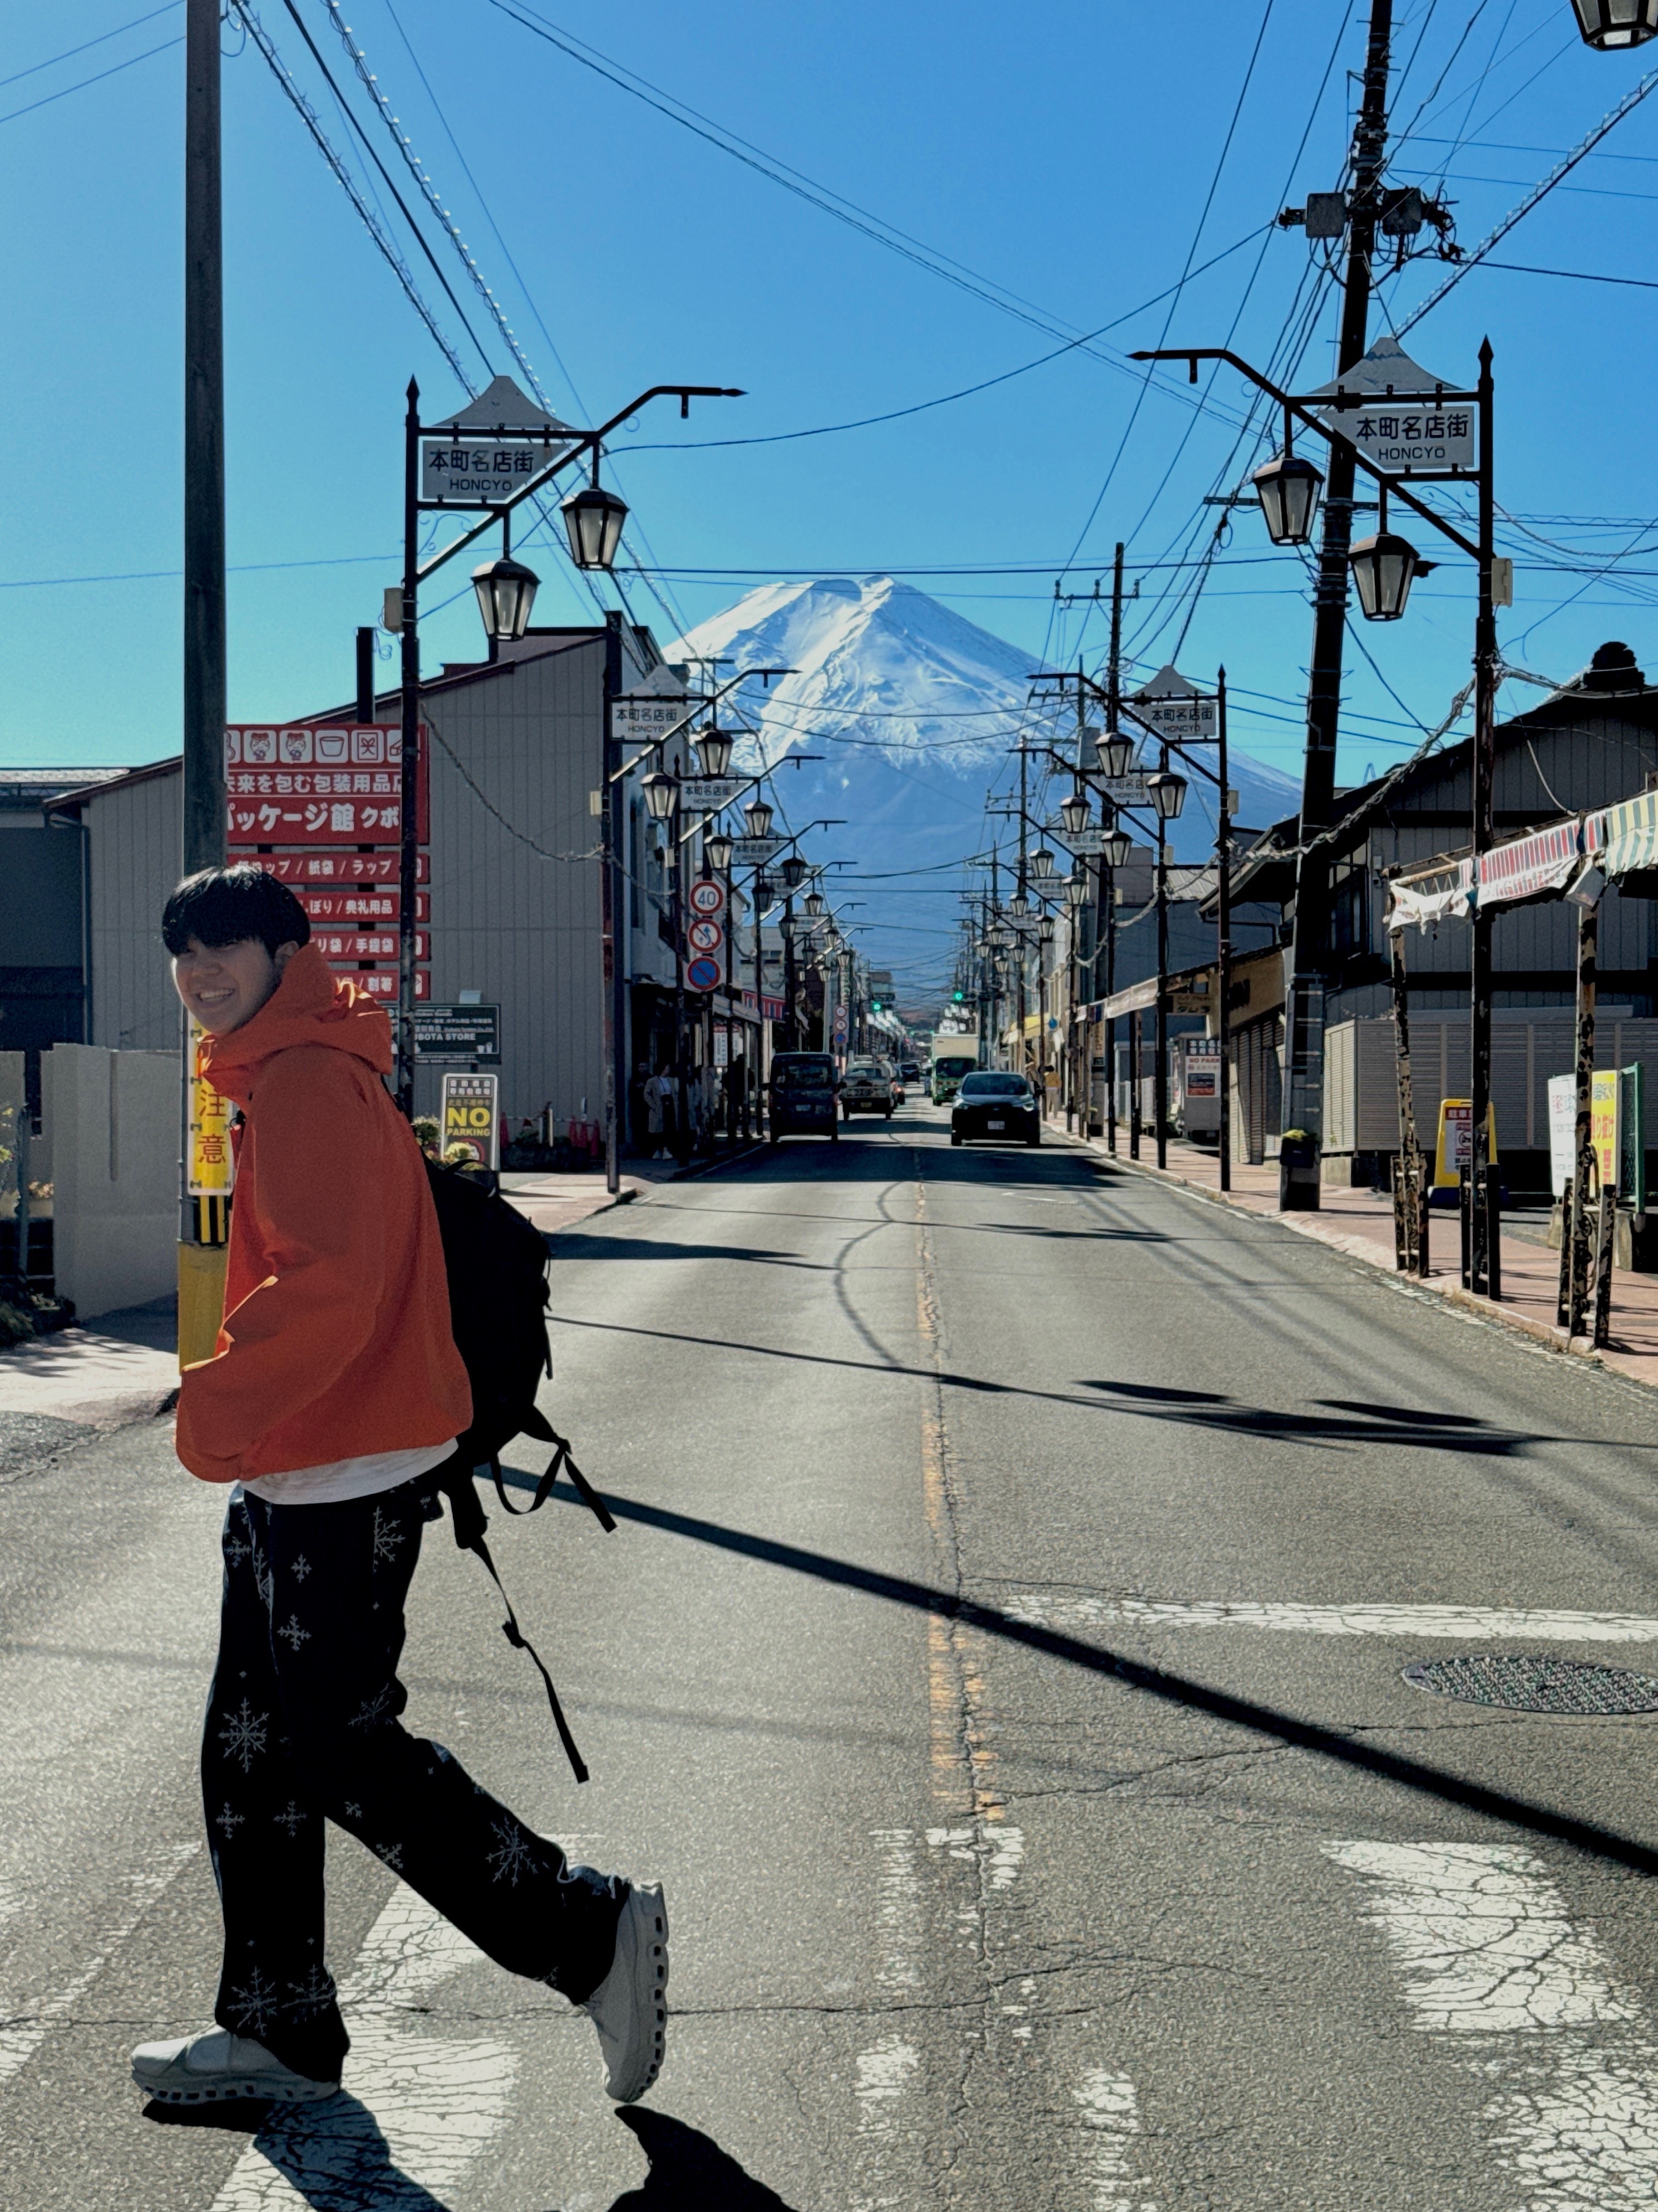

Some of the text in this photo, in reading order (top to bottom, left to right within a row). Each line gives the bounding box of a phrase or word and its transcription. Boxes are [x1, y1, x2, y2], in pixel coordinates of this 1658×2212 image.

[1356, 413, 1468, 441] 本町名店街
[429, 449, 534, 473] 本町名店街
[1378, 446, 1445, 461] HONCYO
[450, 479, 512, 491] HONCYO
[616, 708, 678, 722] 本町名店街
[1151, 707, 1213, 723] 本町名店街
[698, 890, 715, 907] 40
[447, 1107, 490, 1127] NO
[198, 1088, 226, 1164] 注意
[447, 1128, 490, 1137] PARKING
